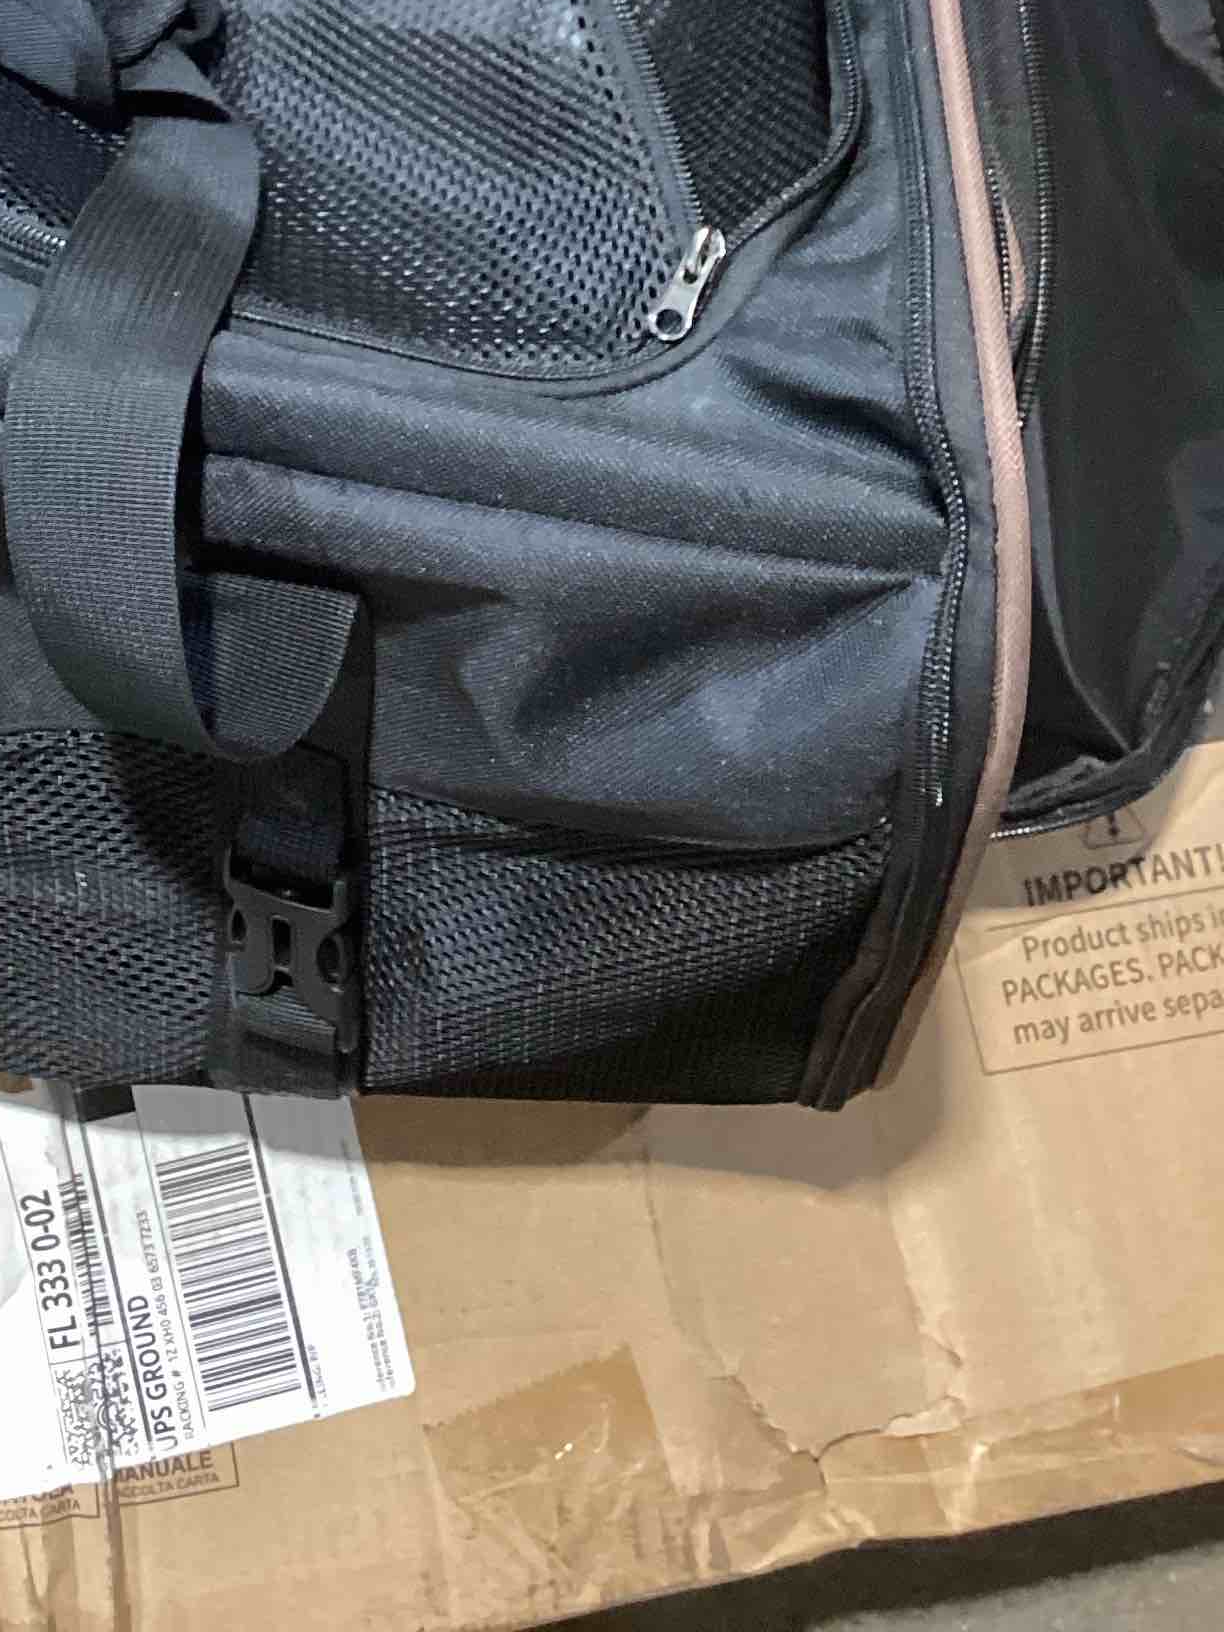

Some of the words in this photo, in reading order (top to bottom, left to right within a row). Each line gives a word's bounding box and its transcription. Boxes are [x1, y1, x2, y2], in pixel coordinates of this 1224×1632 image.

[1022, 923, 1131, 963] Product
[1138, 908, 1206, 943] ships
[1002, 957, 1153, 1007] PACKAGES.
[1013, 1016, 1070, 1045] may
[1079, 1000, 1157, 1033] arrive
[20, 1187, 60, 1254] 0-02
[33, 1255, 73, 1314] 333
[45, 1314, 81, 1351] FL
[125, 1292, 168, 1403] GROUND
[149, 1404, 179, 1452] UPS
